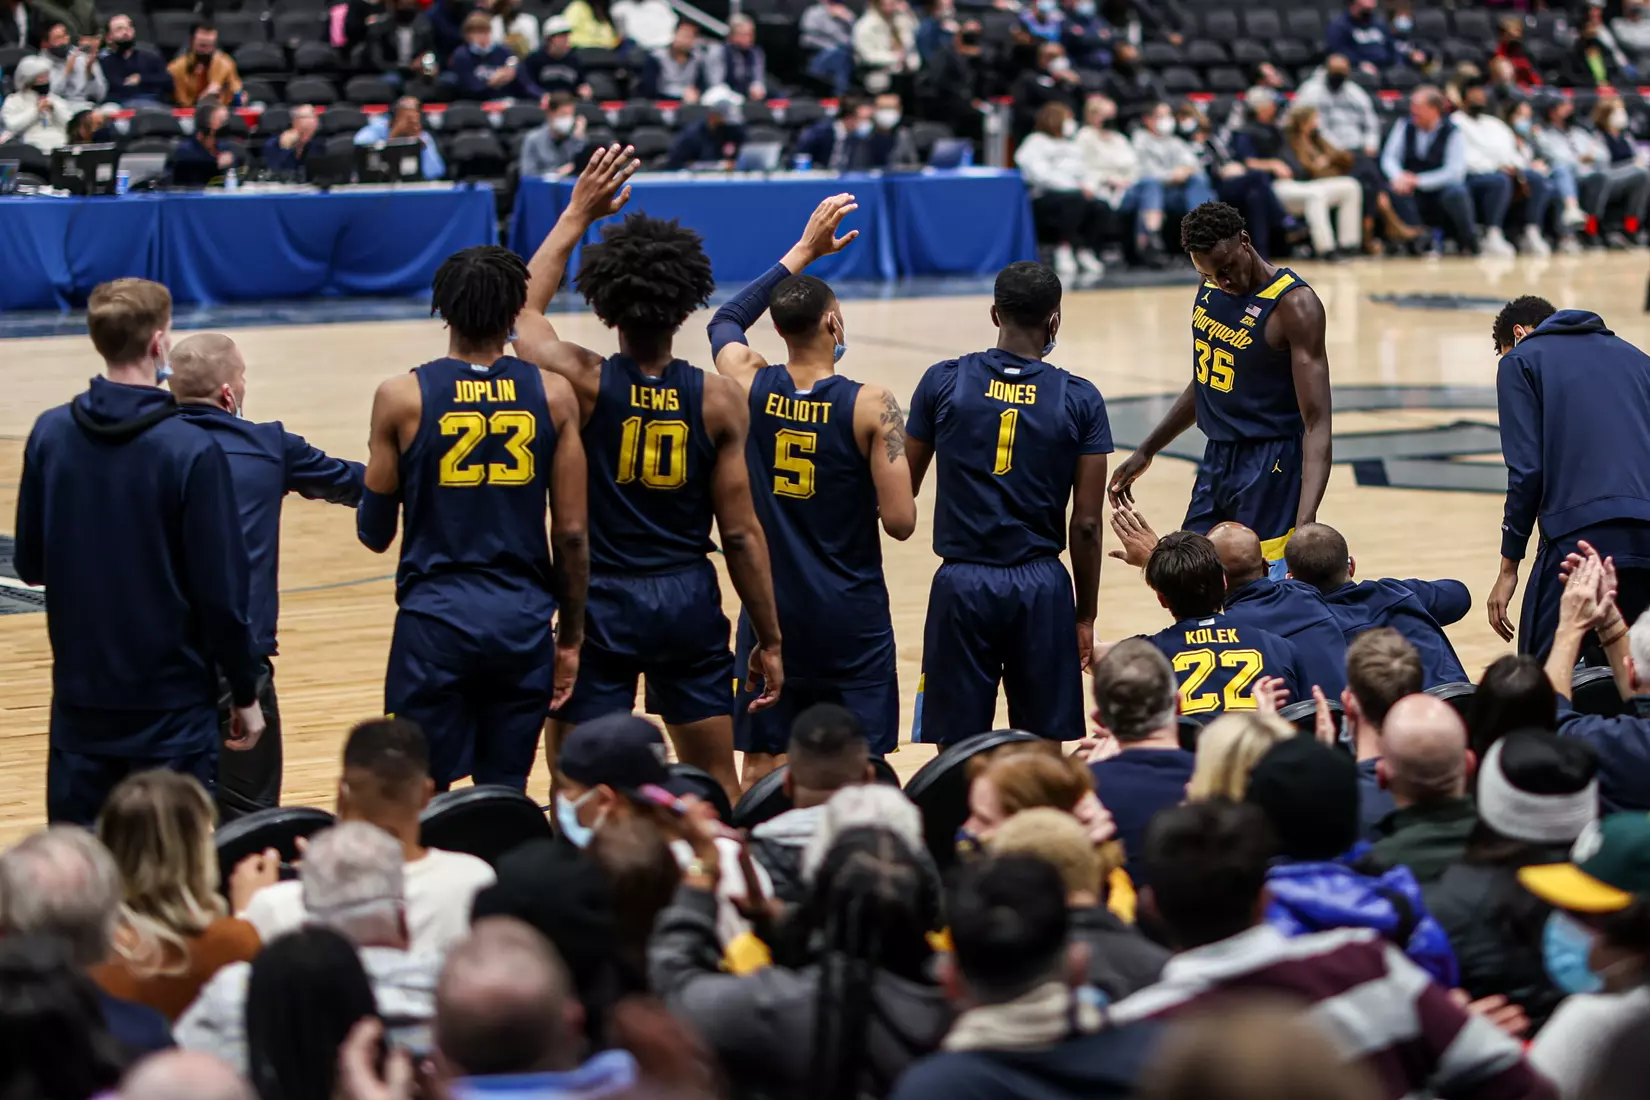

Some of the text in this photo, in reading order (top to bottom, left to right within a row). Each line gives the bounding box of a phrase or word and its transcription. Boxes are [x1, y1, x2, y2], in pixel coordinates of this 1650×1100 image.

[1192, 305, 1253, 349] Marquette
[453, 379, 517, 403] JOPLIN
[984, 379, 1037, 405] JONES
[1195, 338, 1235, 393] 35
[765, 392, 832, 424] ELLIOTT
[438, 410, 536, 487] 23
[615, 416, 689, 489] 10
[773, 428, 816, 499] 5
[992, 408, 1018, 476] 1
[1185, 628, 1240, 645] KOLEK
[1172, 648, 1264, 715] 22
